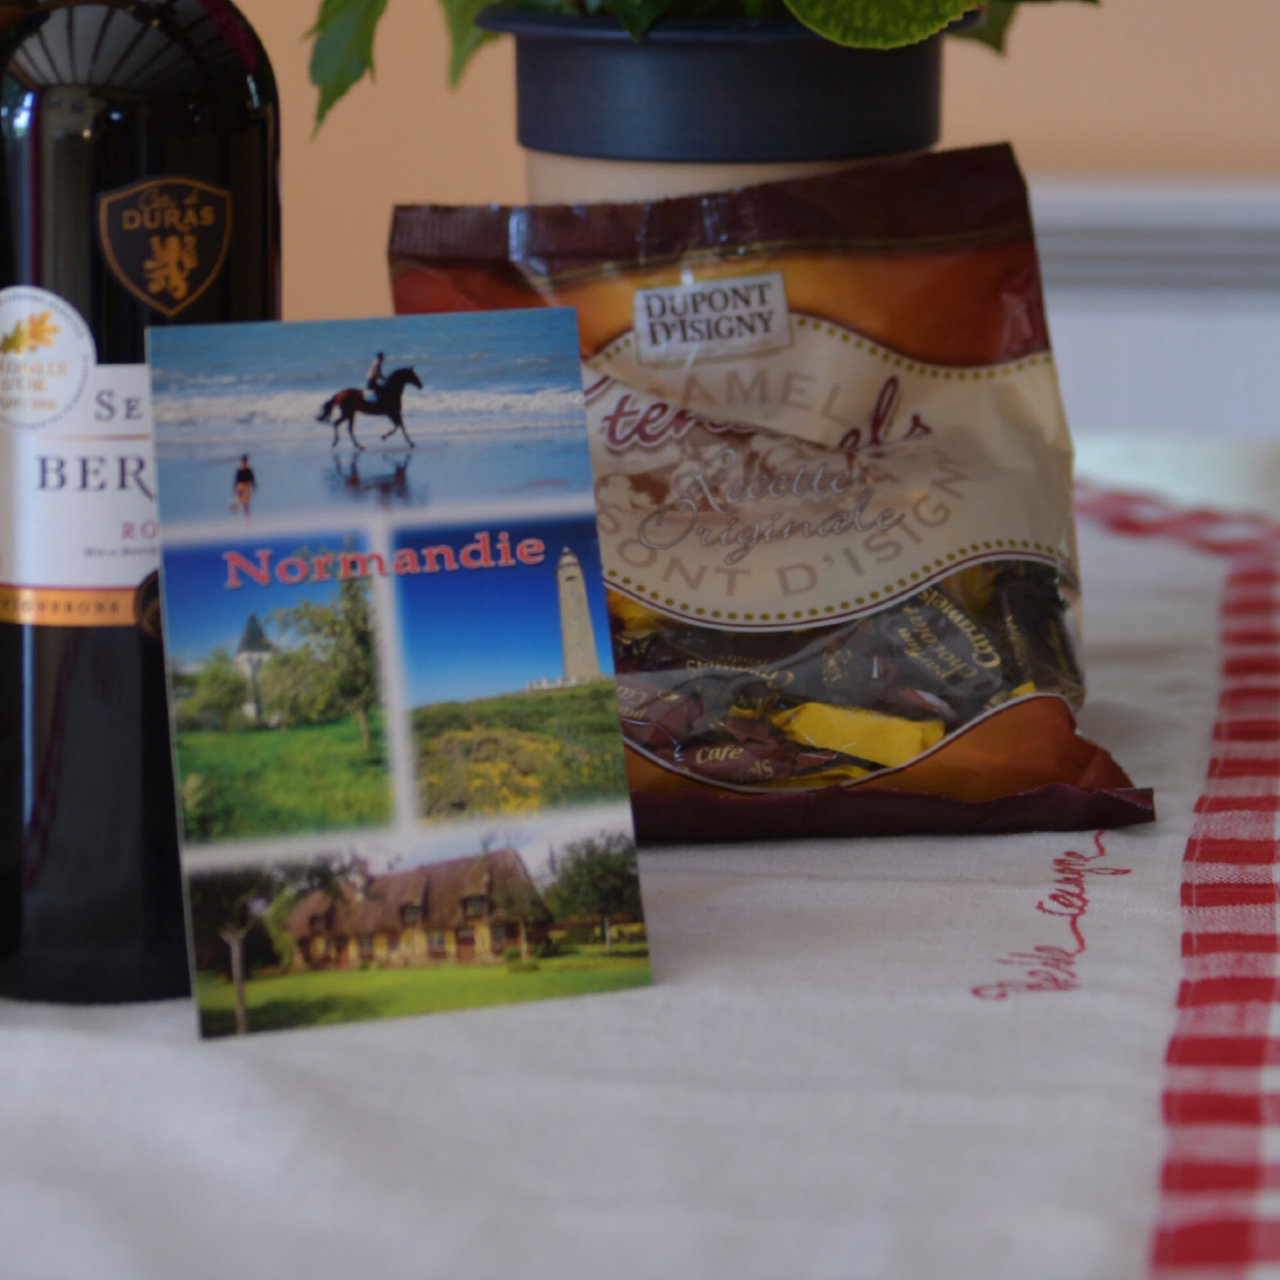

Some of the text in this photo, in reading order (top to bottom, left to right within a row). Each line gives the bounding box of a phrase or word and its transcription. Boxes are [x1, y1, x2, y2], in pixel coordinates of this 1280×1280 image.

[122, 204, 216, 235] DURAS
[644, 282, 772, 321] DUPONT
[647, 310, 774, 347] D'ISIGNY
[637, 482, 907, 565] Originale
[222, 530, 546, 589] Normandie
[919, 587, 1002, 671] Caramels
